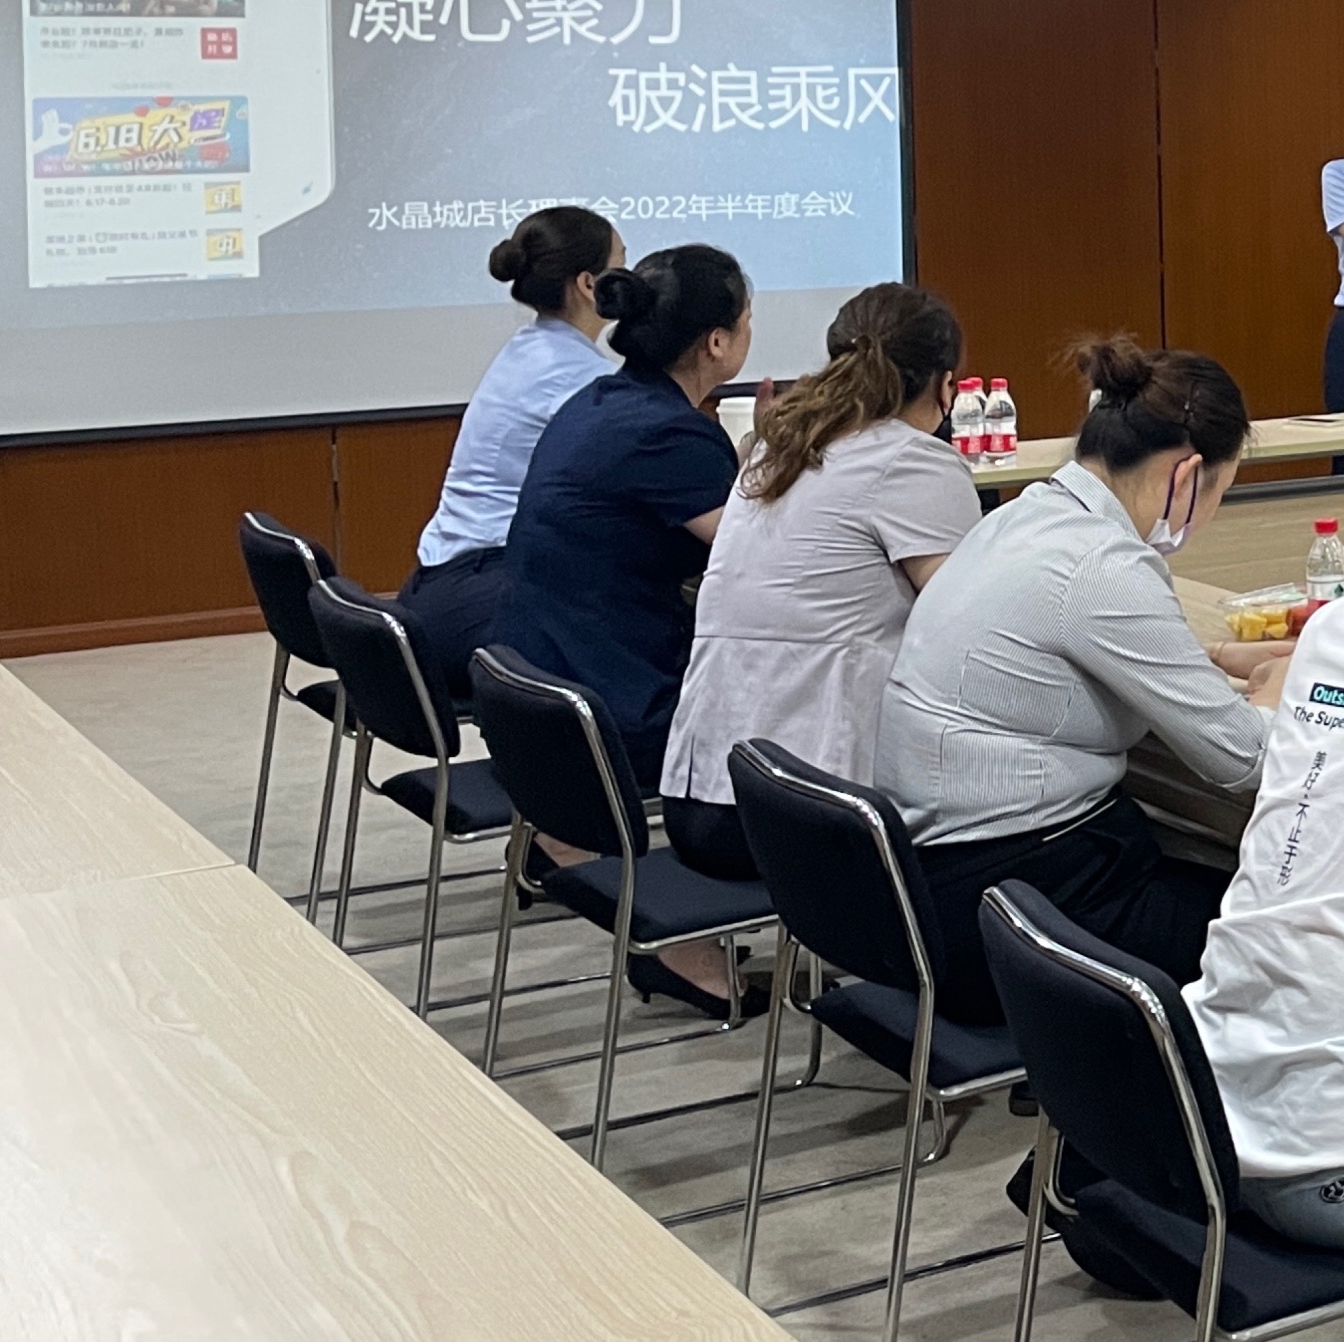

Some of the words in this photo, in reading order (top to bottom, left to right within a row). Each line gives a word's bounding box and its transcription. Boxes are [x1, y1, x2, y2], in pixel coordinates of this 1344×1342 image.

[606, 62, 899, 133] 破浪乘风
[1294, 705, 1314, 723] The
